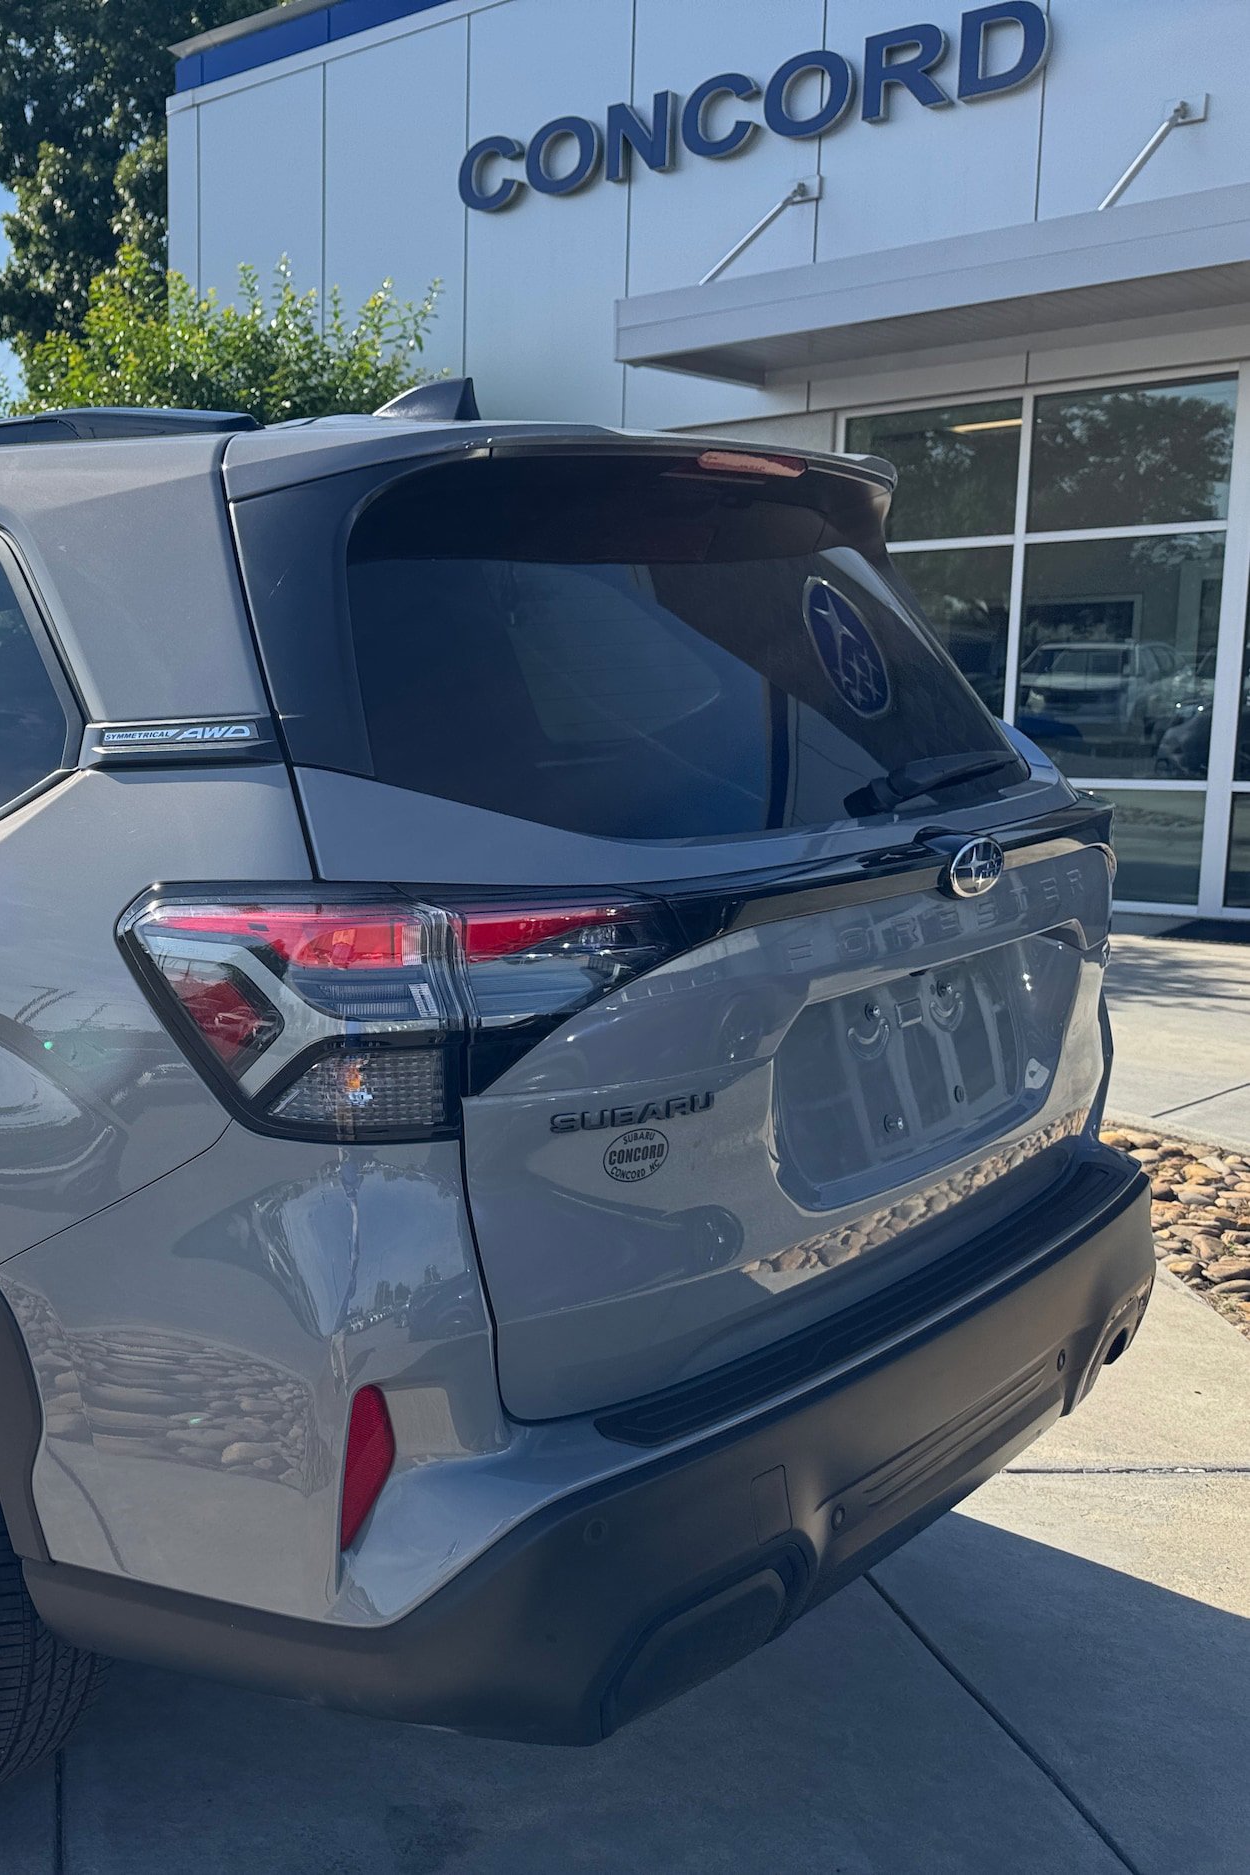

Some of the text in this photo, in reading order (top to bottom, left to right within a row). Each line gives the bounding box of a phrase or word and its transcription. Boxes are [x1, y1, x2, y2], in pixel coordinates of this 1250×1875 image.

[458, 1, 1051, 211] CONCORD
[105, 725, 250, 741] SYMMETRICAL AWD
[550, 1091, 715, 1133] SUBARU
[623, 1131, 656, 1145] SUBARU
[608, 1143, 665, 1165] CONCORD
[610, 1159, 661, 1180] CONCORD NC
